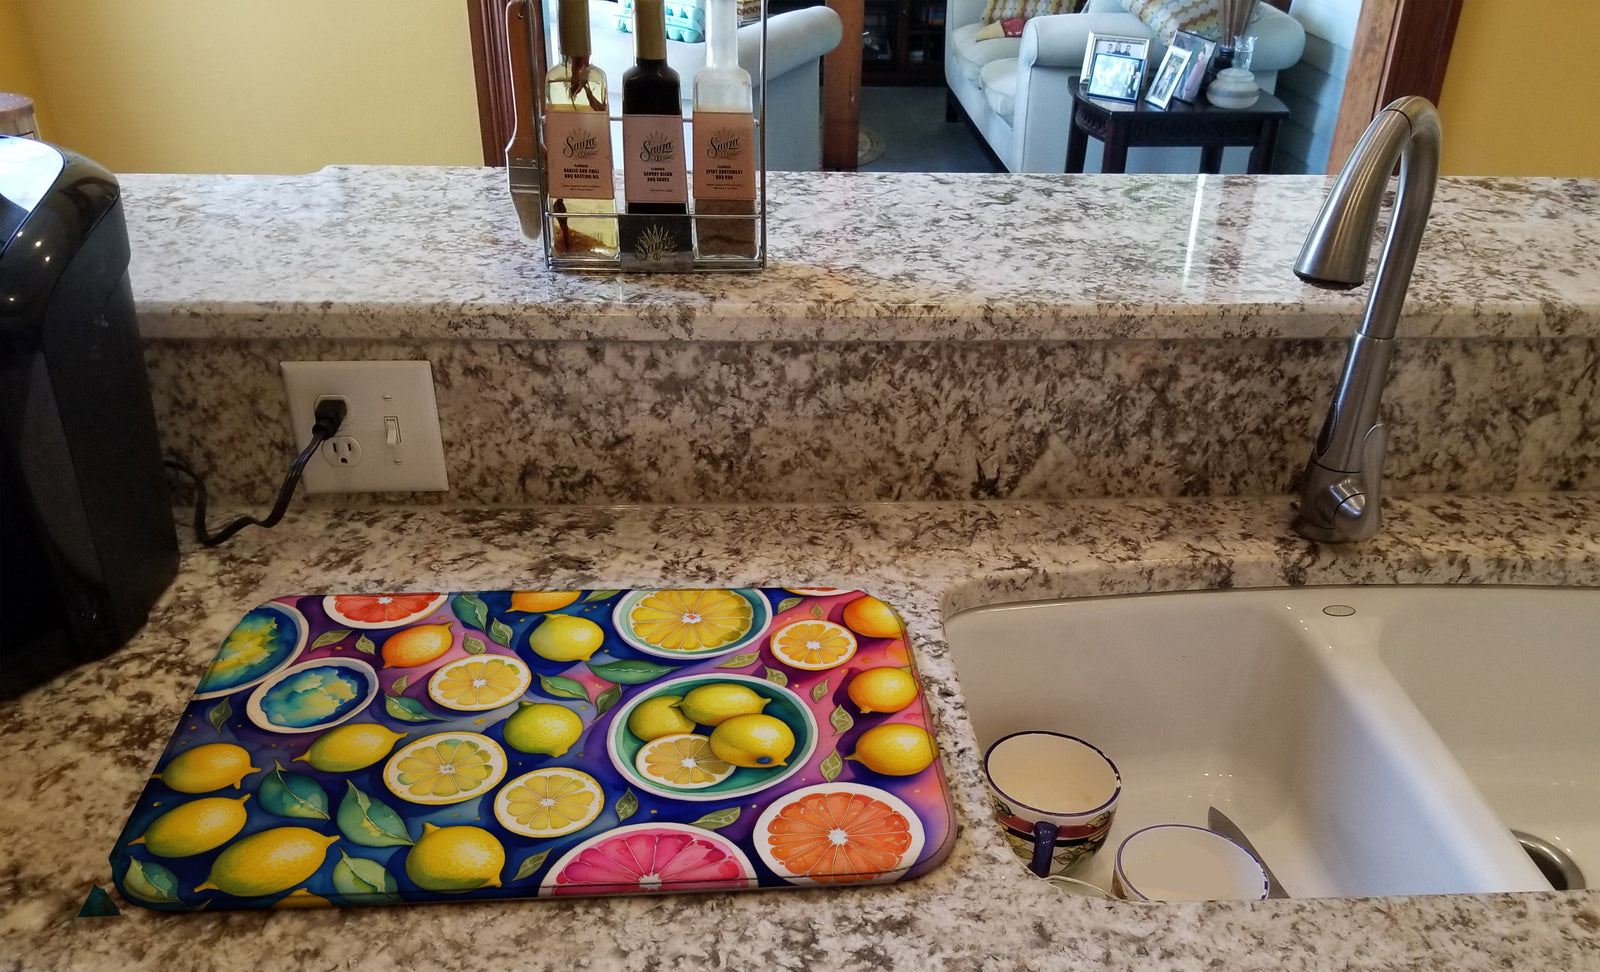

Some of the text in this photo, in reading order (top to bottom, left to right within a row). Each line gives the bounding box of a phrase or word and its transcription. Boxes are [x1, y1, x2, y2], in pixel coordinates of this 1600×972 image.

[563, 136, 597, 158] Sauza
[640, 140, 674, 162] Sauza
[707, 136, 740, 159] Sauza
